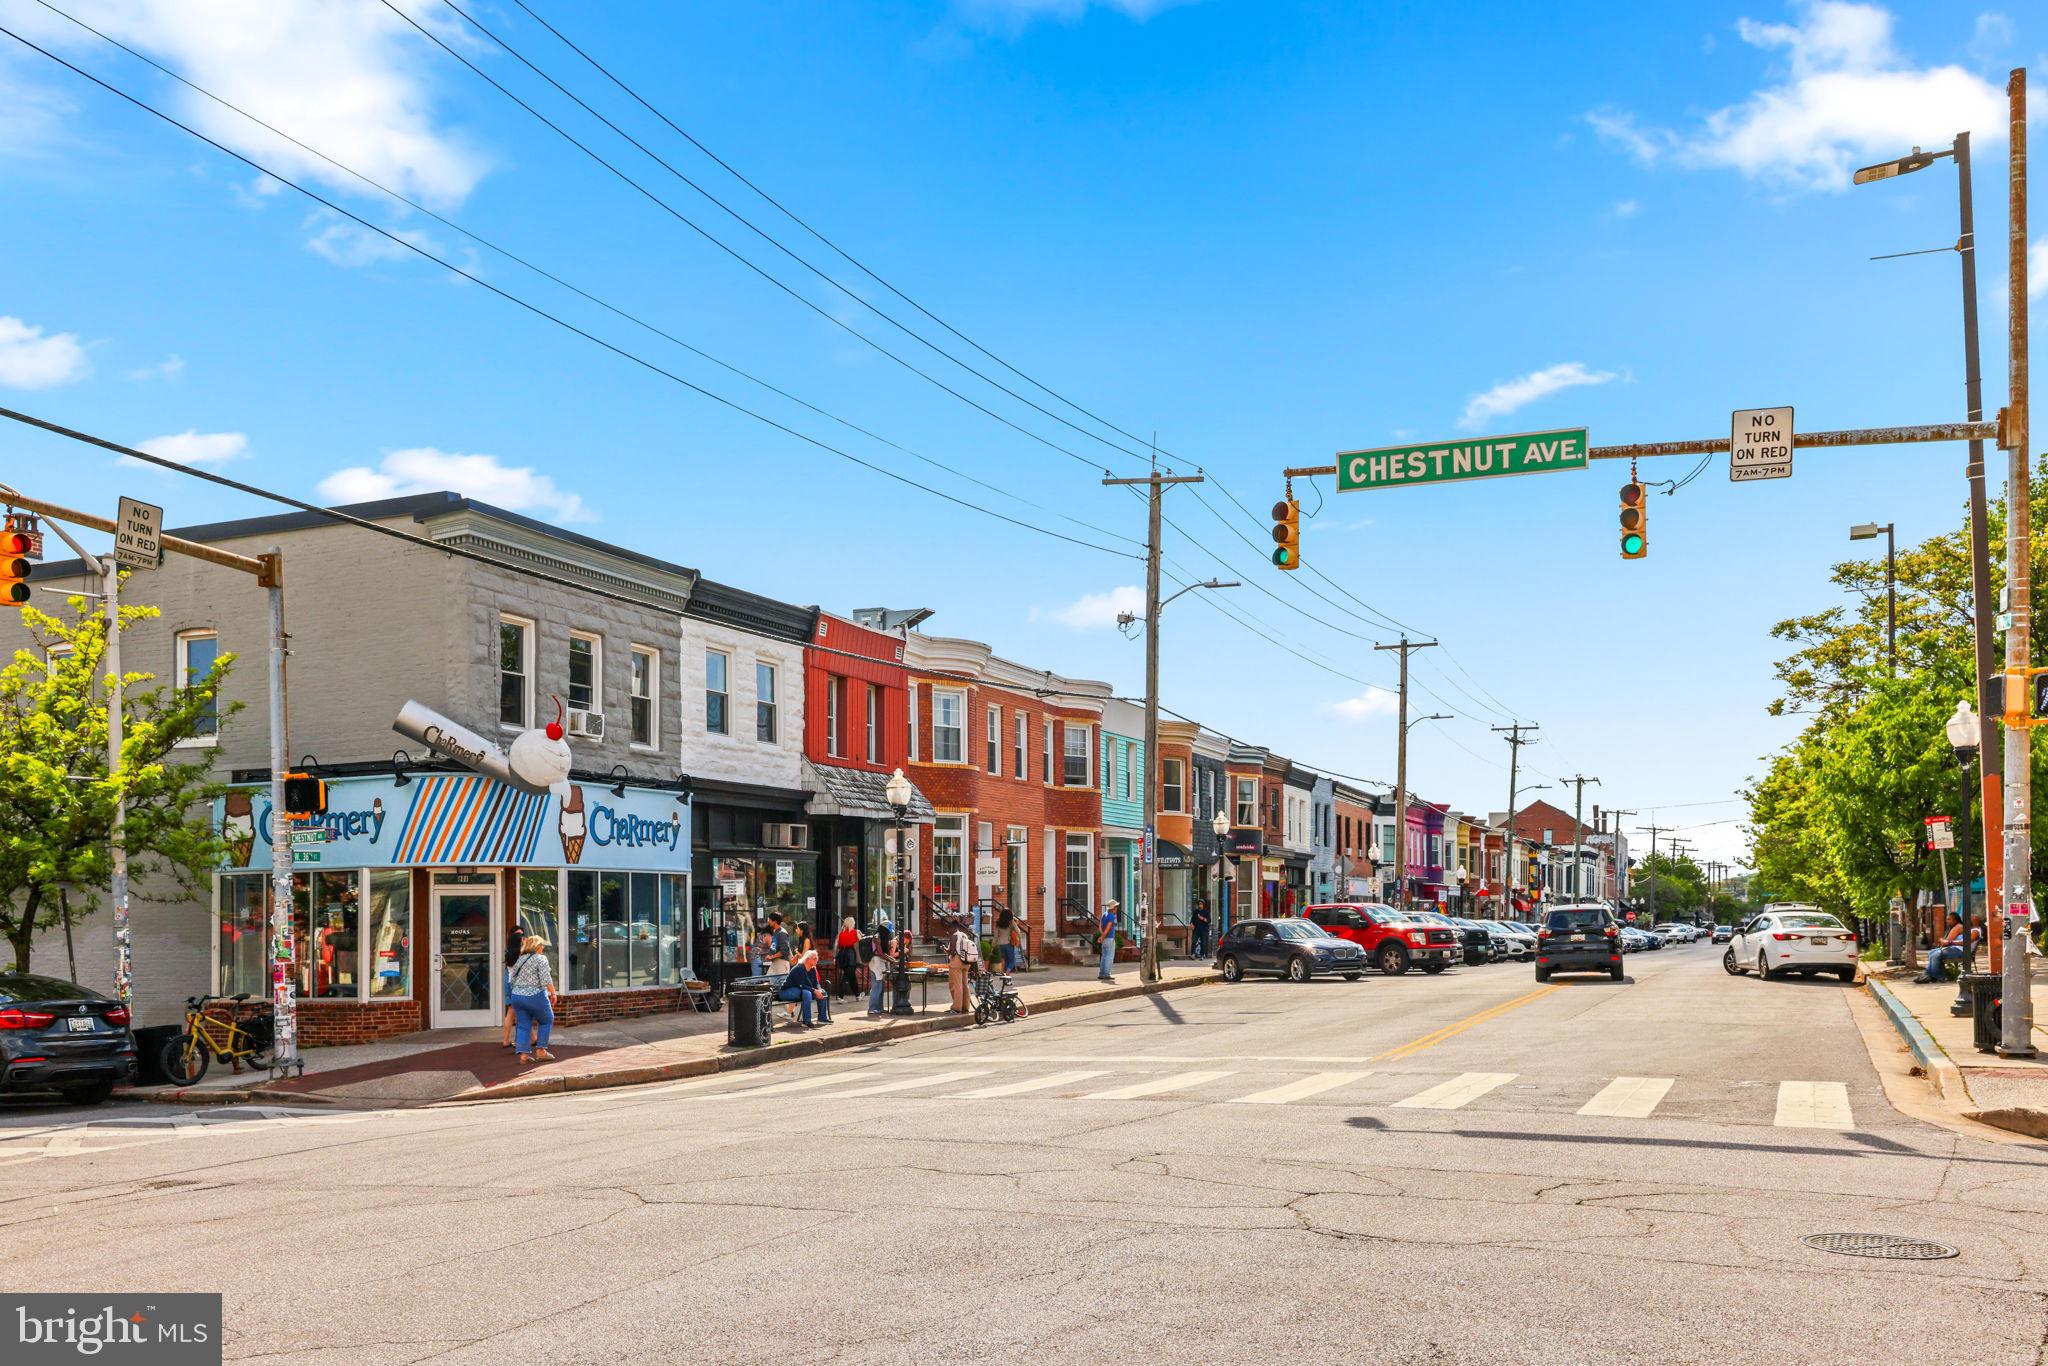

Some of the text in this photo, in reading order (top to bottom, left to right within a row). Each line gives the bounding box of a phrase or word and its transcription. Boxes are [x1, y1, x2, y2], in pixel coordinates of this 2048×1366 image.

[1752, 415, 1775, 427] NO
[1745, 430, 1780, 444] TURN
[1736, 446, 1788, 460] ON RED
[1349, 439, 1583, 484] CHESTNUT AVE.
[1735, 467, 1785, 479] 7AM-7PM
[133, 507, 150, 520] NO
[127, 519, 153, 536] TURN
[119, 533, 156, 551] ON RED
[117, 551, 153, 566] 7AM-7PM
[291, 832, 317, 843] CHESTNUT
